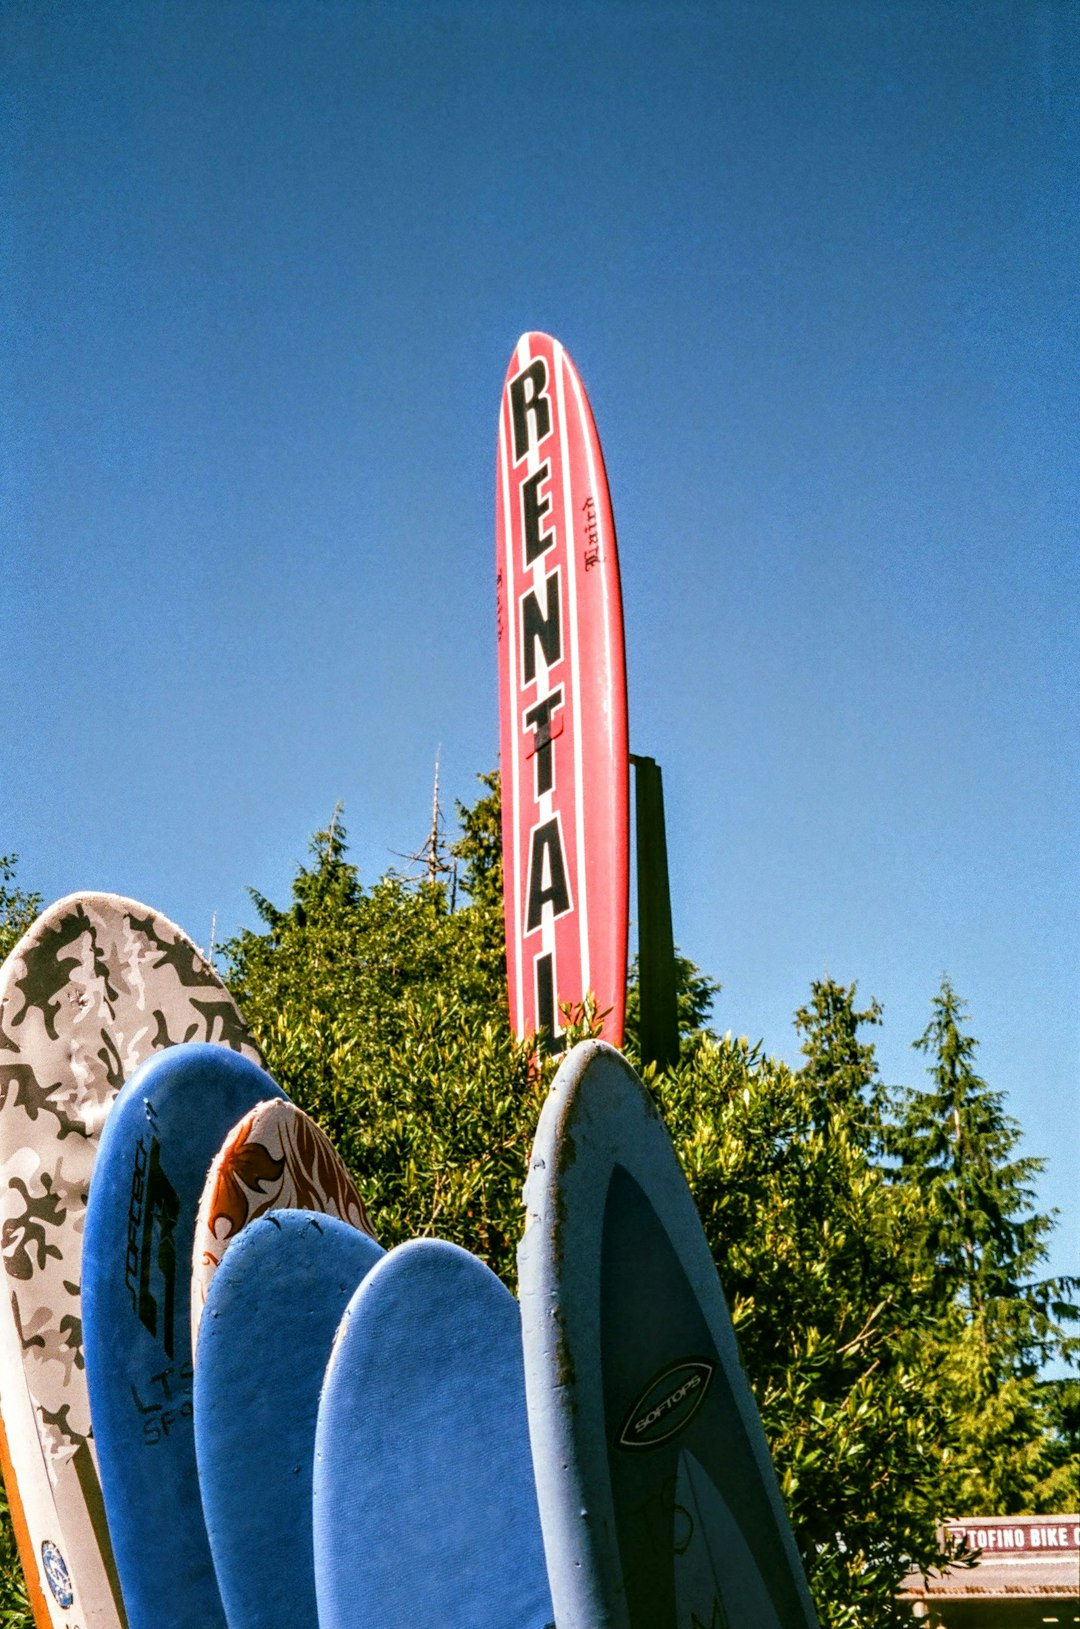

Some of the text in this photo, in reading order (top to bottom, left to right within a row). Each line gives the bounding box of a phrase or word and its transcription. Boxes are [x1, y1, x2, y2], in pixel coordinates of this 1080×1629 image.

[582, 497, 601, 573] Laird
[508, 356, 571, 1058] RENTAL
[634, 1375, 702, 1433] SOFTOPS
[967, 1528, 1025, 1549] TOFINO
[1029, 1527, 1069, 1547] BIKE
